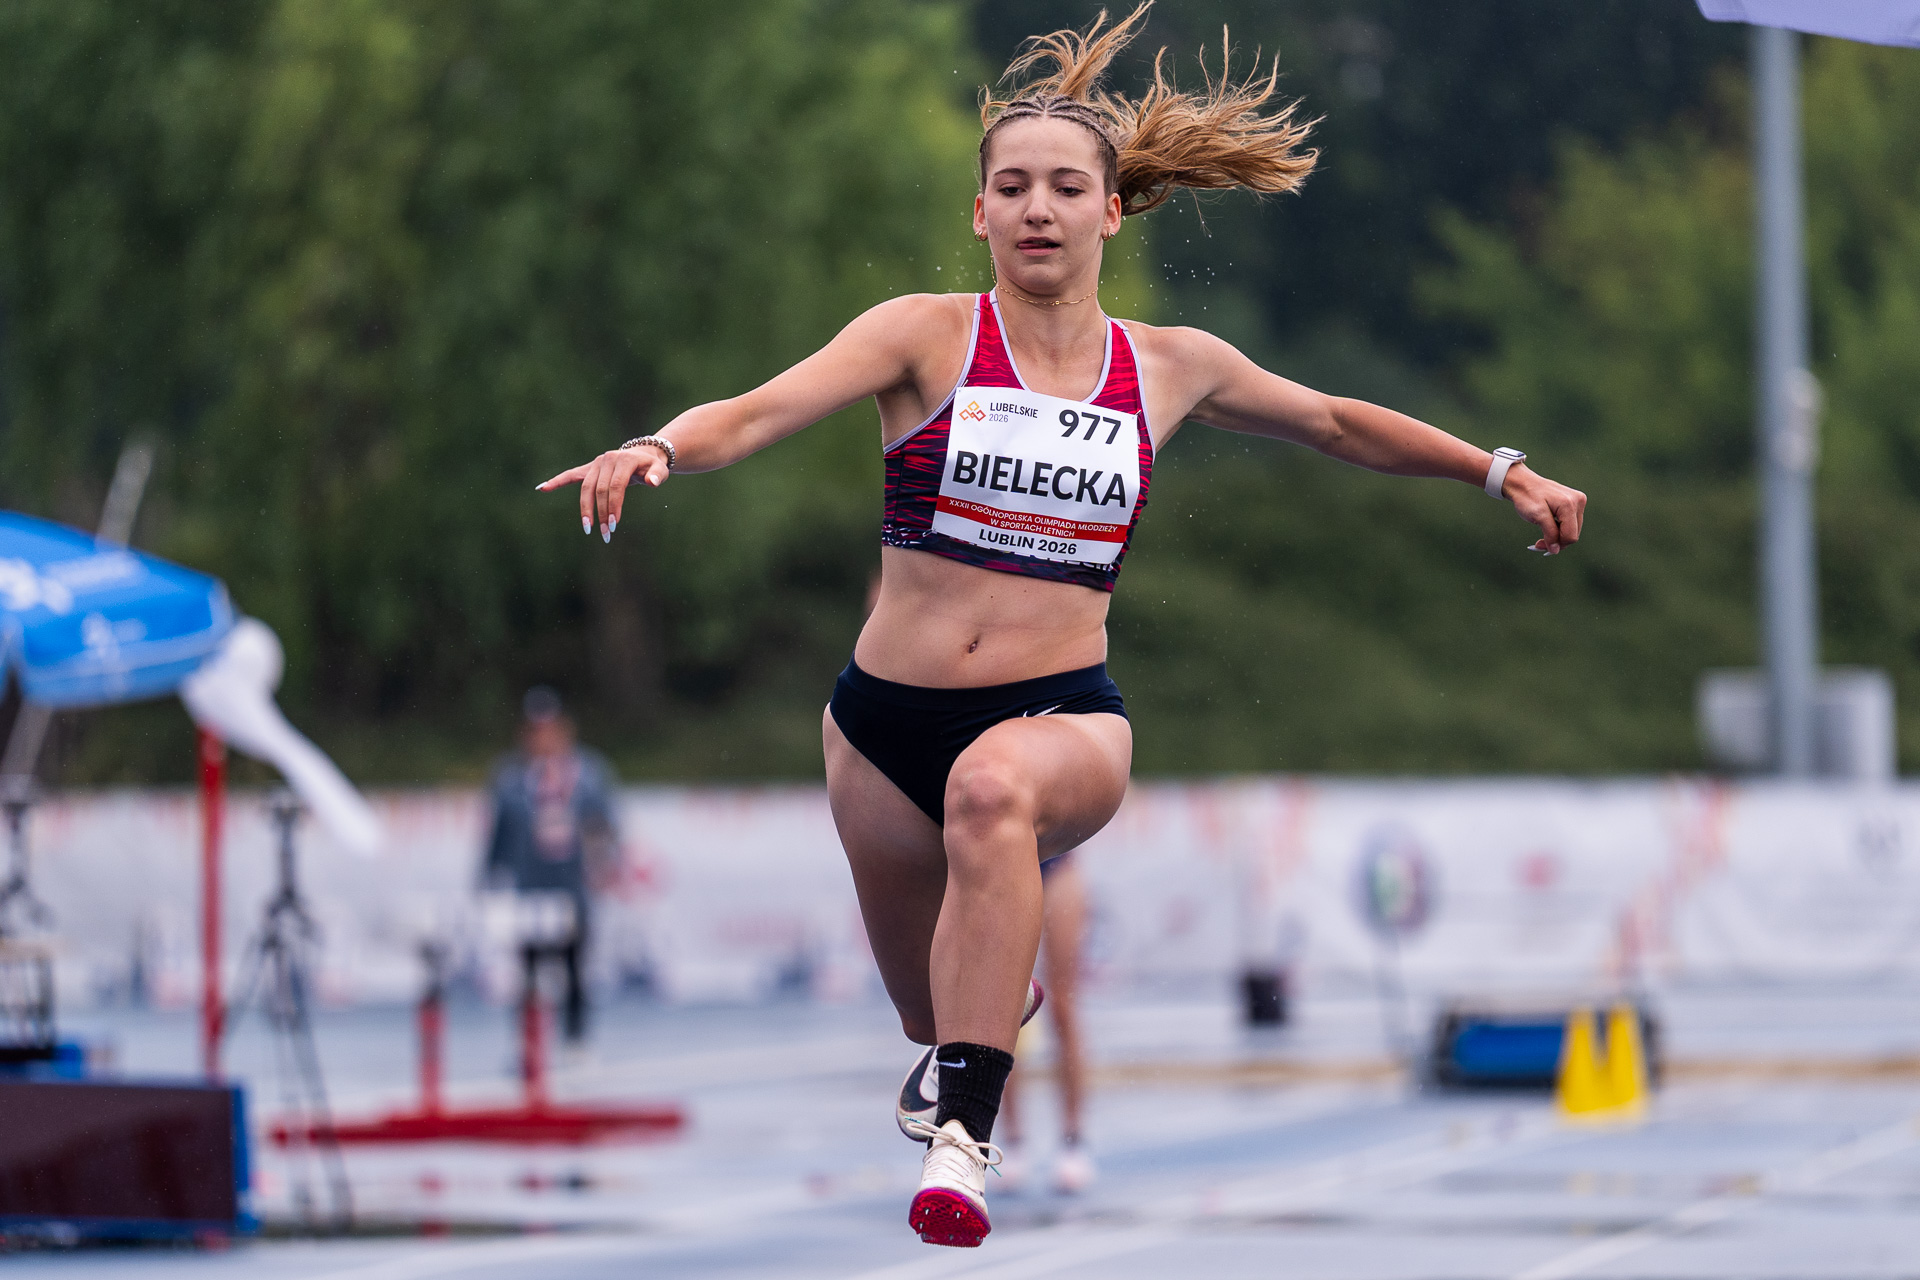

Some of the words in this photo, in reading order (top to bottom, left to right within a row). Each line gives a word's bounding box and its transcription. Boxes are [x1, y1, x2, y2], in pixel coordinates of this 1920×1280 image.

[989, 413, 1009, 423] 2026
[990, 402, 1038, 418] LUBELSKIE
[1059, 409, 1121, 445] 977
[952, 450, 1127, 508] BIELECKA
[949, 499, 970, 510] XXXII
[970, 504, 1033, 523] OGÓLNOPOLSKA
[1034, 516, 1077, 530] OLIMPIADA
[990, 518, 999, 526] W
[1000, 520, 1042, 533] SPORTACH
[1043, 526, 1075, 538] LETNICH
[979, 528, 1035, 549] LUBLIN
[1037, 539, 1077, 555] 2026
